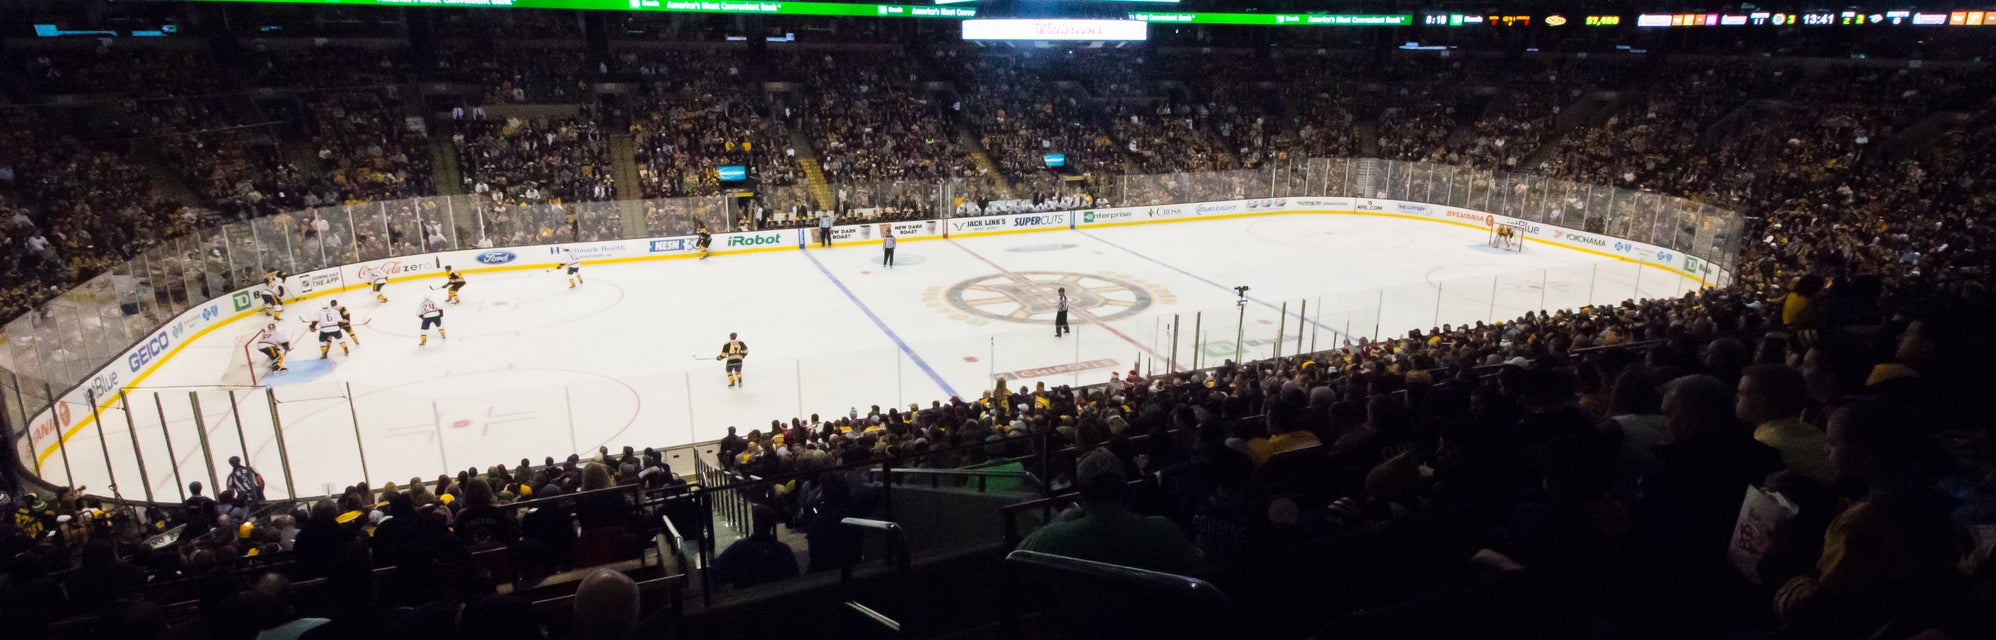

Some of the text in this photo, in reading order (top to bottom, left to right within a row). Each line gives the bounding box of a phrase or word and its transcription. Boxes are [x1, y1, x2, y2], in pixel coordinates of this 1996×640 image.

[667, 1, 700, 10] America's
[702, 2, 720, 10] Most
[721, 2, 760, 11] Convenient
[1787, 13, 1797, 25] 3
[1803, 13, 1835, 25] 13:41
[1855, 13, 1866, 25] 2
[1014, 214, 1064, 227] SUPERCUTS
[1446, 210, 1485, 223] SYLVANIA
[967, 219, 983, 227] JACK
[655, 240, 680, 251] NESN
[728, 233, 781, 247] iRobot
[1565, 232, 1607, 247] YOKOHAMA
[483, 251, 509, 263] Ford
[403, 262, 432, 272] zero
[312, 276, 339, 288] THE APP
[128, 331, 169, 373] GEICO
